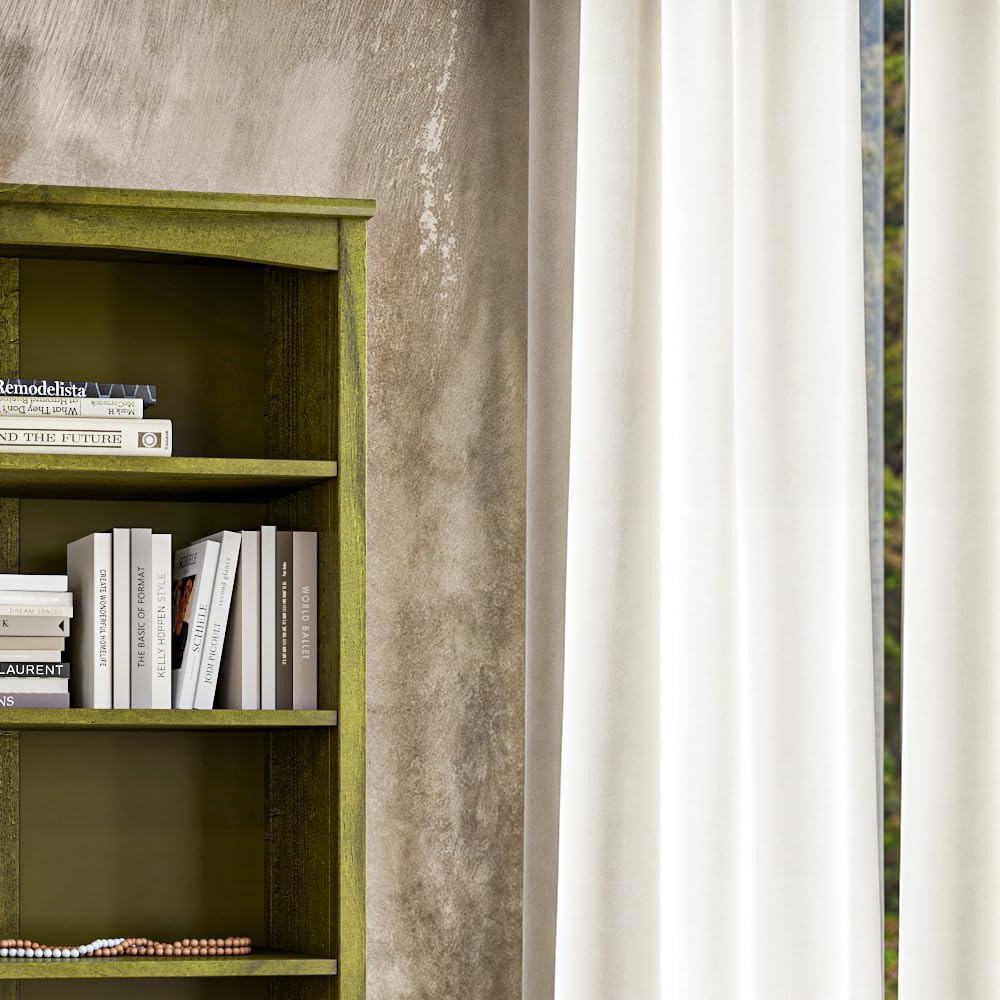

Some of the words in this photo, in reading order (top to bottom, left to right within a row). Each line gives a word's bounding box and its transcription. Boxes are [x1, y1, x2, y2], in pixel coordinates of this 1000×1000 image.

[2, 405, 26, 414] Don't
[28, 404, 51, 414] They
[52, 406, 78, 415] What
[91, 400, 135, 408] McCormack
[23, 432, 56, 442] THE
[60, 433, 122, 444] FUTURE
[99, 569, 107, 593] CREATE
[137, 566, 145, 604] FORMAT
[157, 573, 166, 602] STYLE
[99, 595, 107, 634] WONDERFUL
[137, 607, 145, 619] OF
[301, 585, 310, 621] WORLD
[137, 622, 145, 648] BASIC
[157, 606, 166, 644] HOPPEN
[192, 603, 208, 653] SCHIELE
[99, 635, 107, 667] HOMELIFE
[301, 625, 310, 661] BALLET
[137, 651, 145, 668] THE
[157, 648, 166, 678] KELLY
